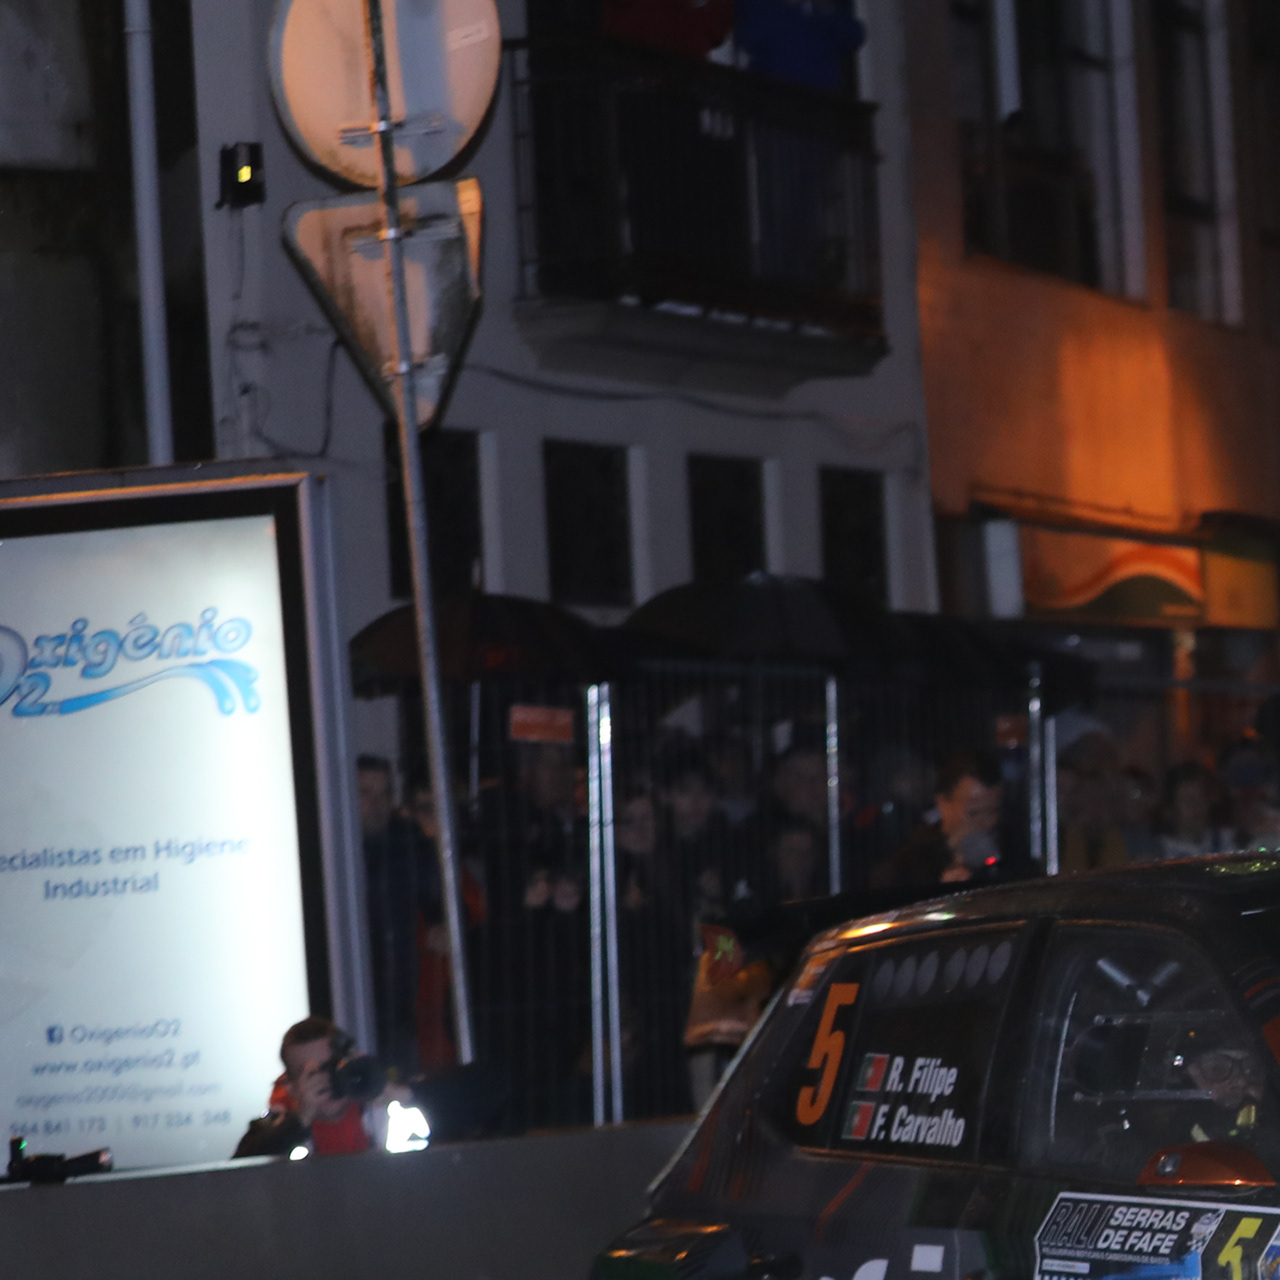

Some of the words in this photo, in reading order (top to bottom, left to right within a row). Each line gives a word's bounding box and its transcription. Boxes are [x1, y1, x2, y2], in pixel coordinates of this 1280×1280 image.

[109, 843, 146, 862] em
[153, 837, 249, 865] Higiene
[43, 871, 160, 900] Industrial
[796, 982, 860, 1126] 5
[885, 1055, 905, 1092] R.
[907, 1056, 958, 1104] Filipe
[870, 1103, 890, 1141] F.
[890, 1104, 966, 1148] Carvalho
[1042, 1202, 1114, 1250] RALI
[1110, 1207, 1190, 1231] SERRAS
[1097, 1229, 1126, 1251] DE
[1127, 1232, 1178, 1254] FAFE
